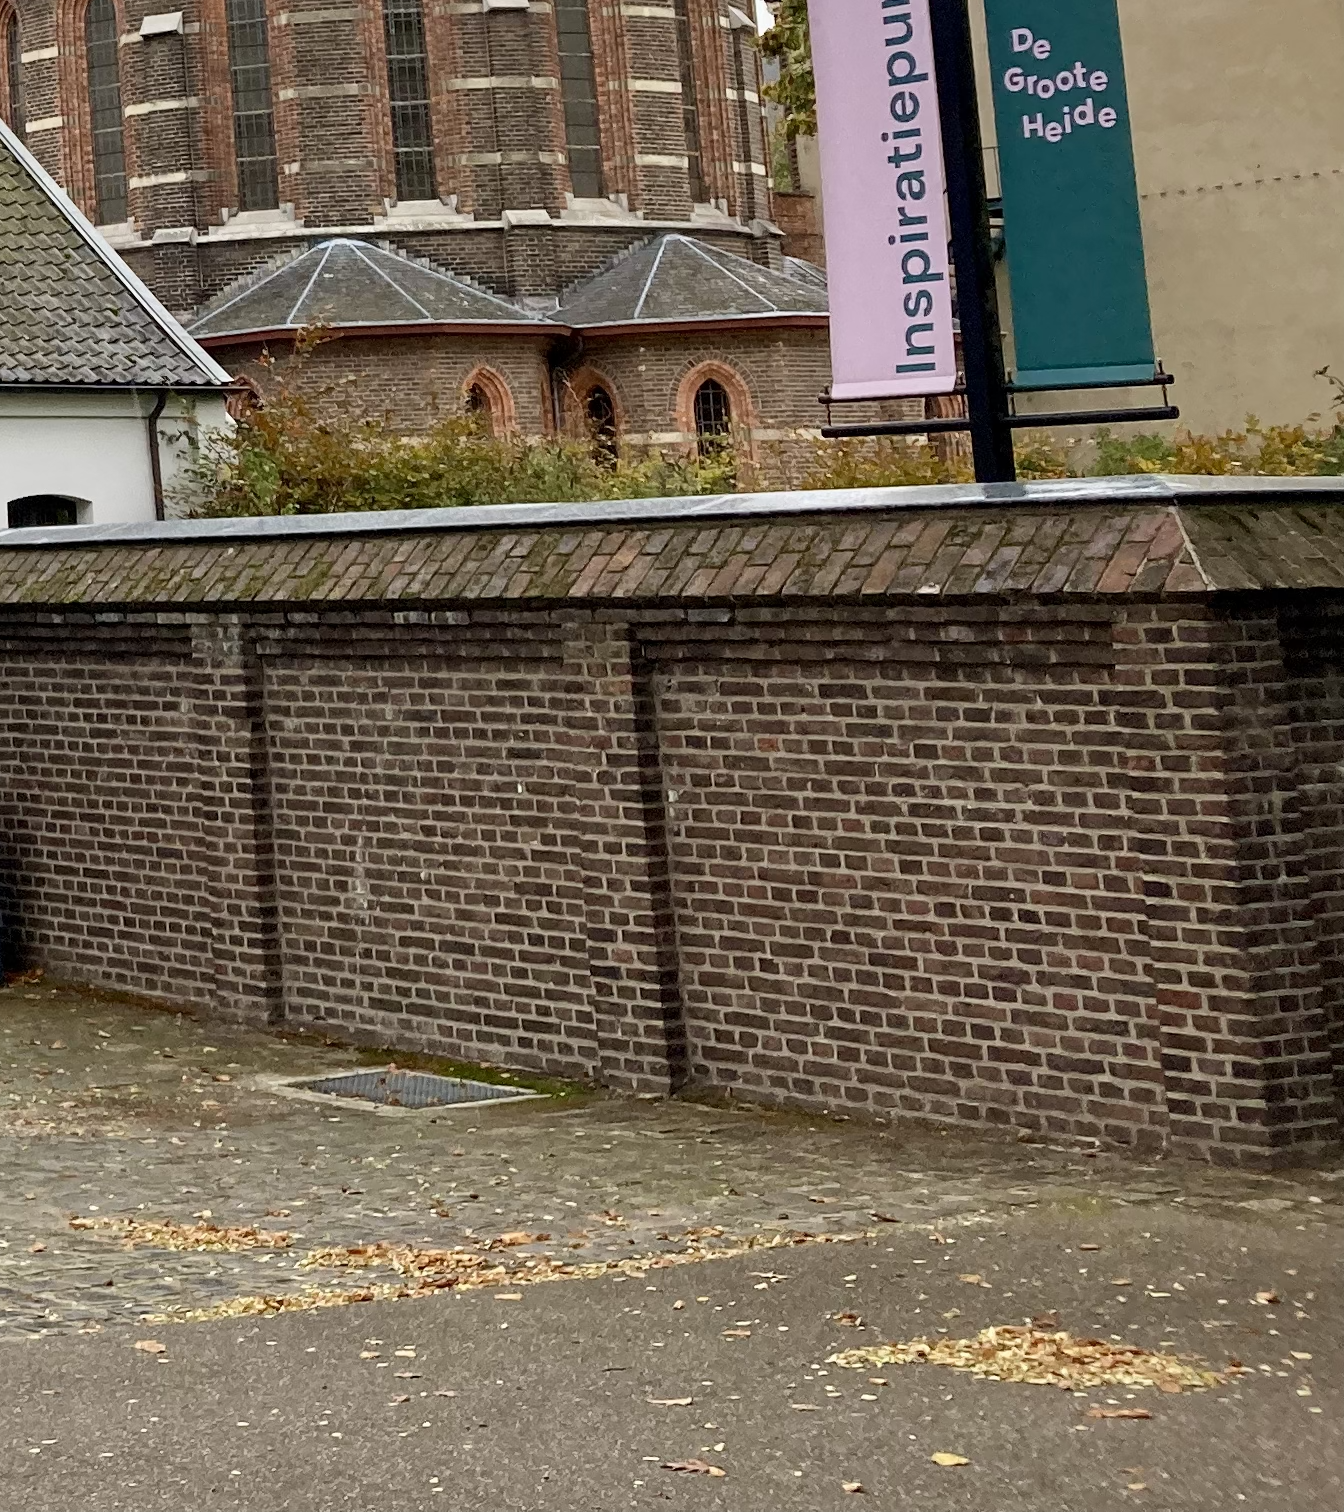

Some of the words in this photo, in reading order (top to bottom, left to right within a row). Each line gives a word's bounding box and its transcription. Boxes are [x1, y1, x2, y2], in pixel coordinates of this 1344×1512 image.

[1011, 27, 1051, 59] De
[1004, 61, 1109, 99] Groote
[1022, 98, 1117, 143] Heide
